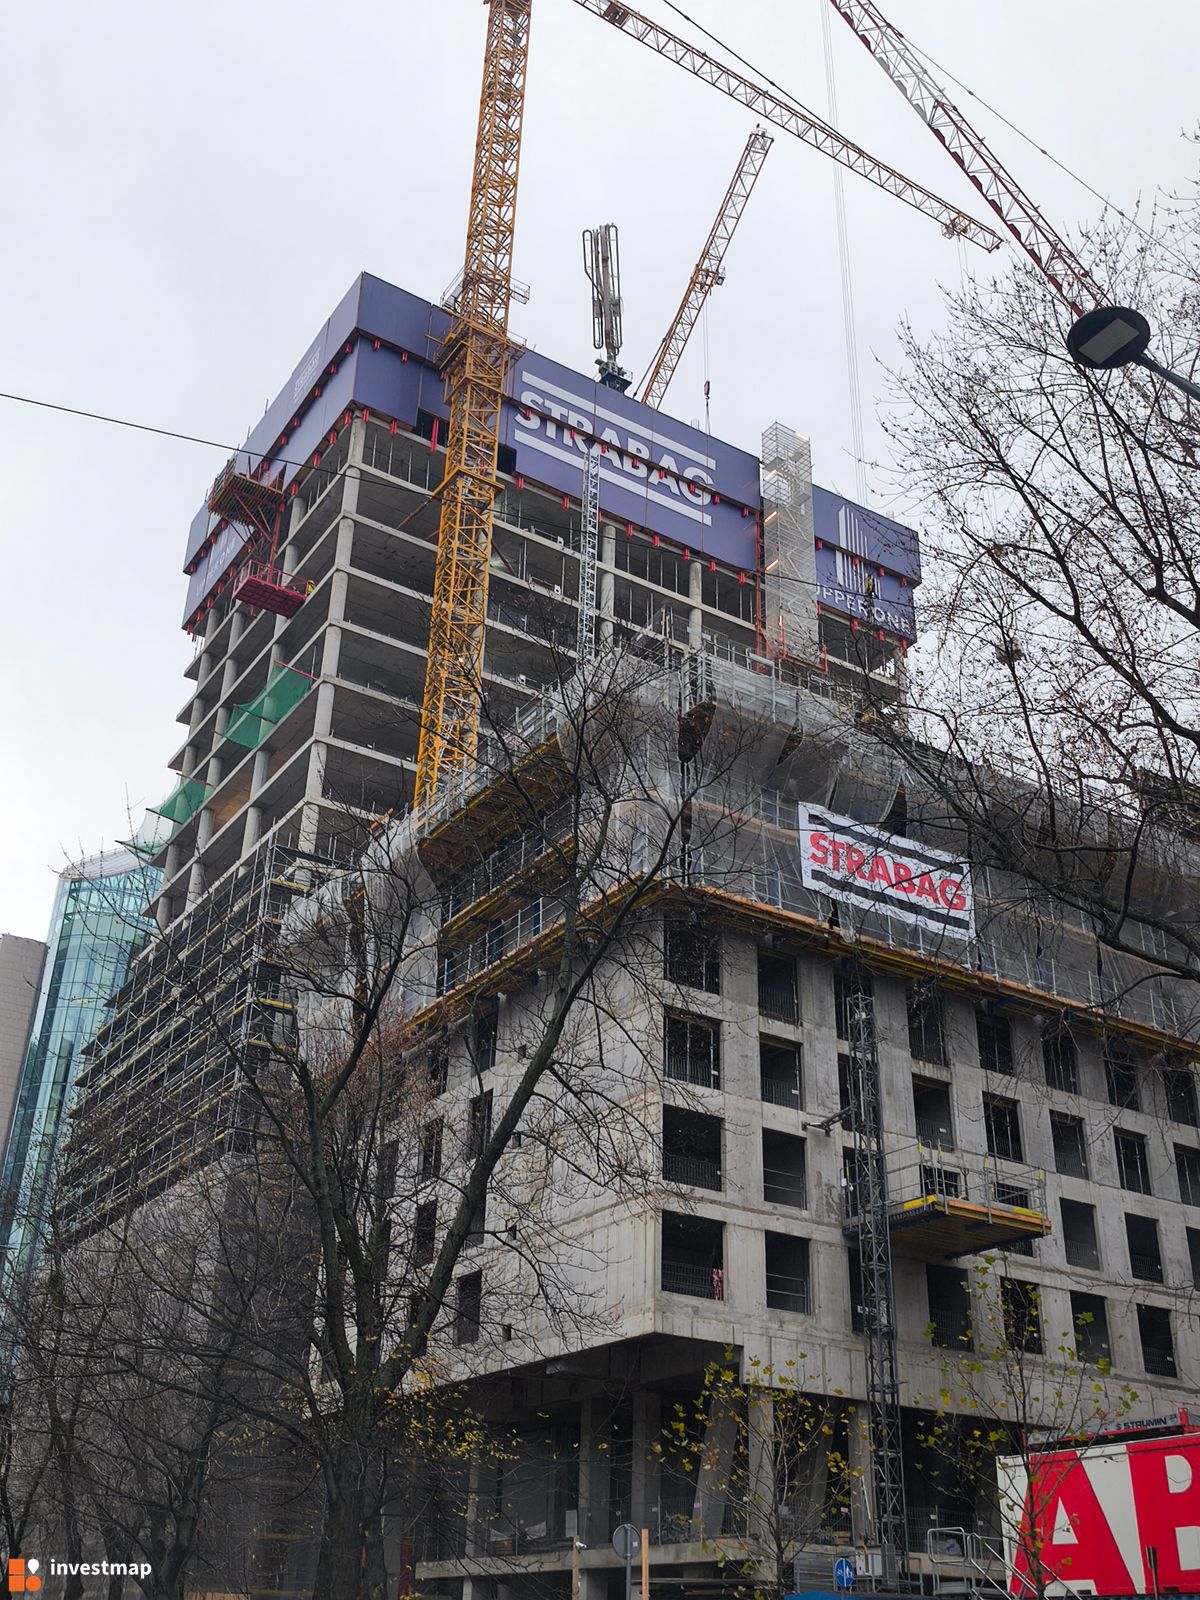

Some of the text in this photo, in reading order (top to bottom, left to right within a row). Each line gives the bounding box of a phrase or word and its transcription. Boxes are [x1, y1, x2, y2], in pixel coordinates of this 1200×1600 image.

[514, 390, 714, 506] STRABAG
[809, 832, 967, 911] STRABAG
[1123, 1416, 1167, 1429] STRUMIN
